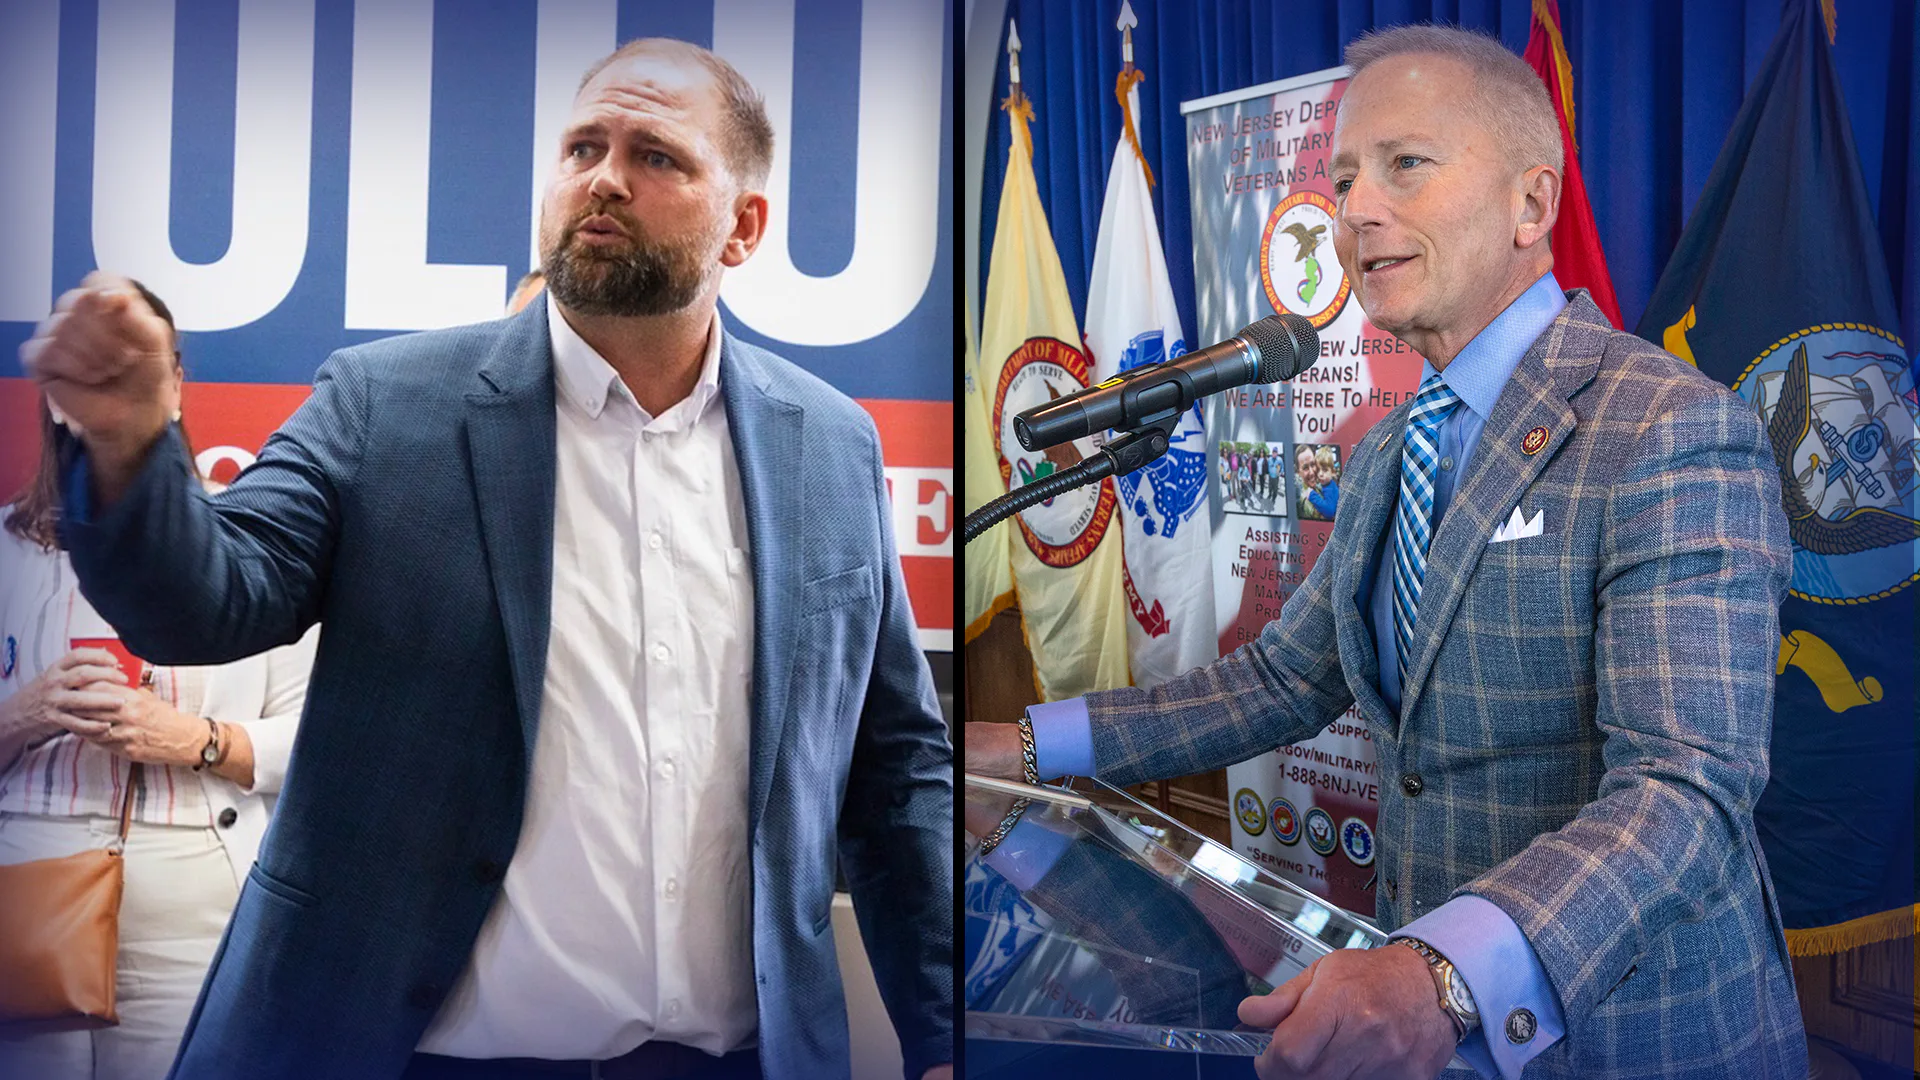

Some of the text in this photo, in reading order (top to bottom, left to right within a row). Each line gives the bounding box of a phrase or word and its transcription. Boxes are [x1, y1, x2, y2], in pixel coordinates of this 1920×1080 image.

[1192, 123, 1227, 145] NEW
[1232, 108, 1294, 138] JERSEY
[1230, 131, 1333, 166] OF MILITARY
[1222, 165, 1307, 195] VETERANS
[1274, 193, 1305, 217] MILITARY
[1310, 192, 1326, 206] AND
[1266, 221, 1275, 235] OF
[1261, 237, 1278, 307] DEPARTMENT
[1320, 340, 1346, 357] EW
[1294, 362, 1360, 383] ERANS!
[1225, 389, 1248, 408] WE
[1253, 389, 1286, 408] ARE
[1292, 388, 1335, 408] HERE
[1341, 387, 1362, 407] TO
[1297, 413, 1336, 433] YOU!
[1035, 341, 1055, 359] OF
[1086, 486, 1117, 547] TERANS
[1245, 526, 1329, 547] ASSISTING S
[1239, 545, 1306, 564] EDUCATING
[1231, 562, 1306, 584] NEW JERSEY
[1122, 568, 1145, 617] RMY
[1255, 584, 1290, 602] MANY
[1328, 721, 1371, 741] SUPPO
[1279, 763, 1377, 801] 1-888-8NJ-VE
